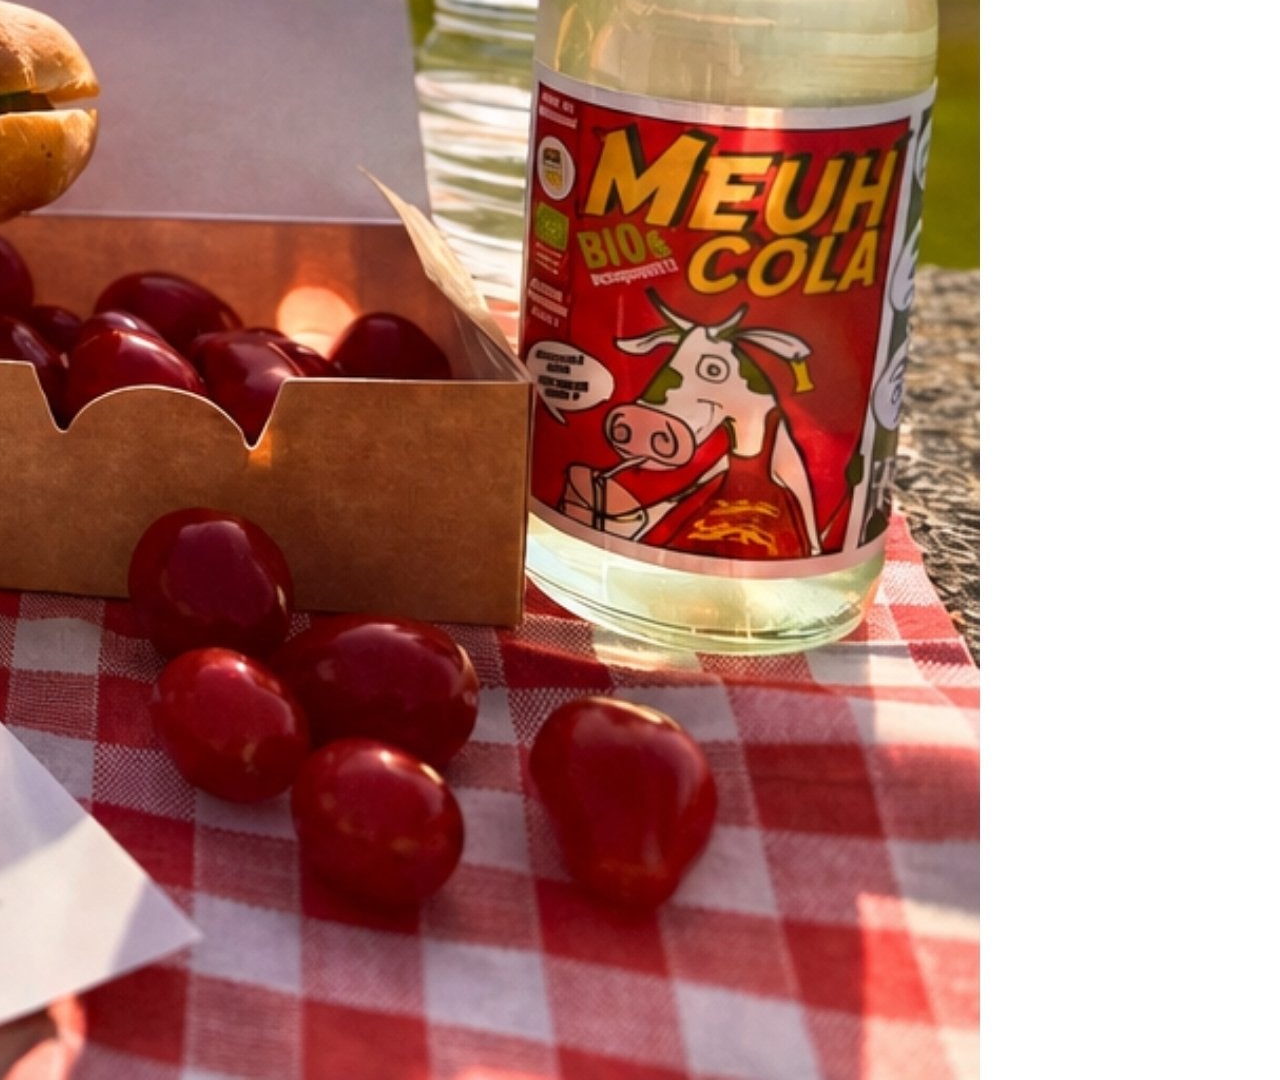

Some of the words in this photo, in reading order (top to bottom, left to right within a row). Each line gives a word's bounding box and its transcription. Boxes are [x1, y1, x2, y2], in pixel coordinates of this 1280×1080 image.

[584, 128, 899, 235] MEUH
[577, 222, 646, 269] BIO
[687, 229, 880, 298] COLA
